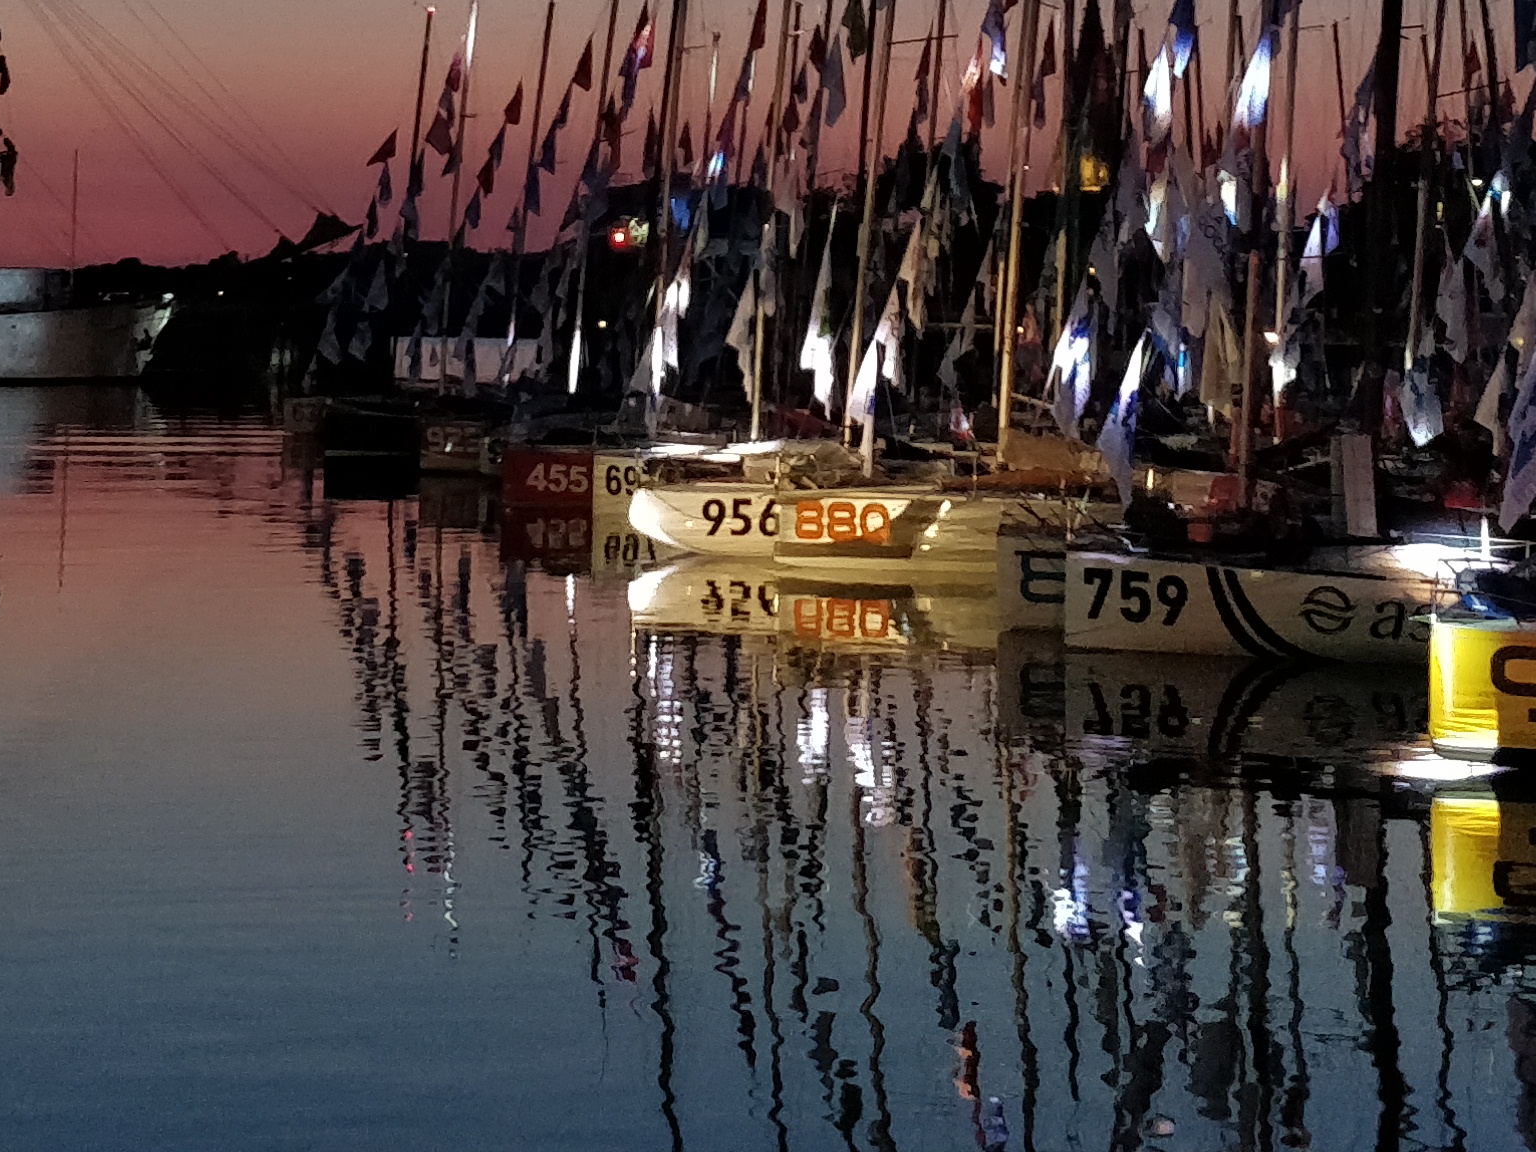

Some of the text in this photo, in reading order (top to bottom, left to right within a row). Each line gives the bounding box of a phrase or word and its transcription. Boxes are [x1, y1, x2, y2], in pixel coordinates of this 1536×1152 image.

[525, 462, 590, 494] 455
[702, 498, 780, 537] 956
[795, 500, 892, 545] 880
[1083, 567, 1189, 626] 759
